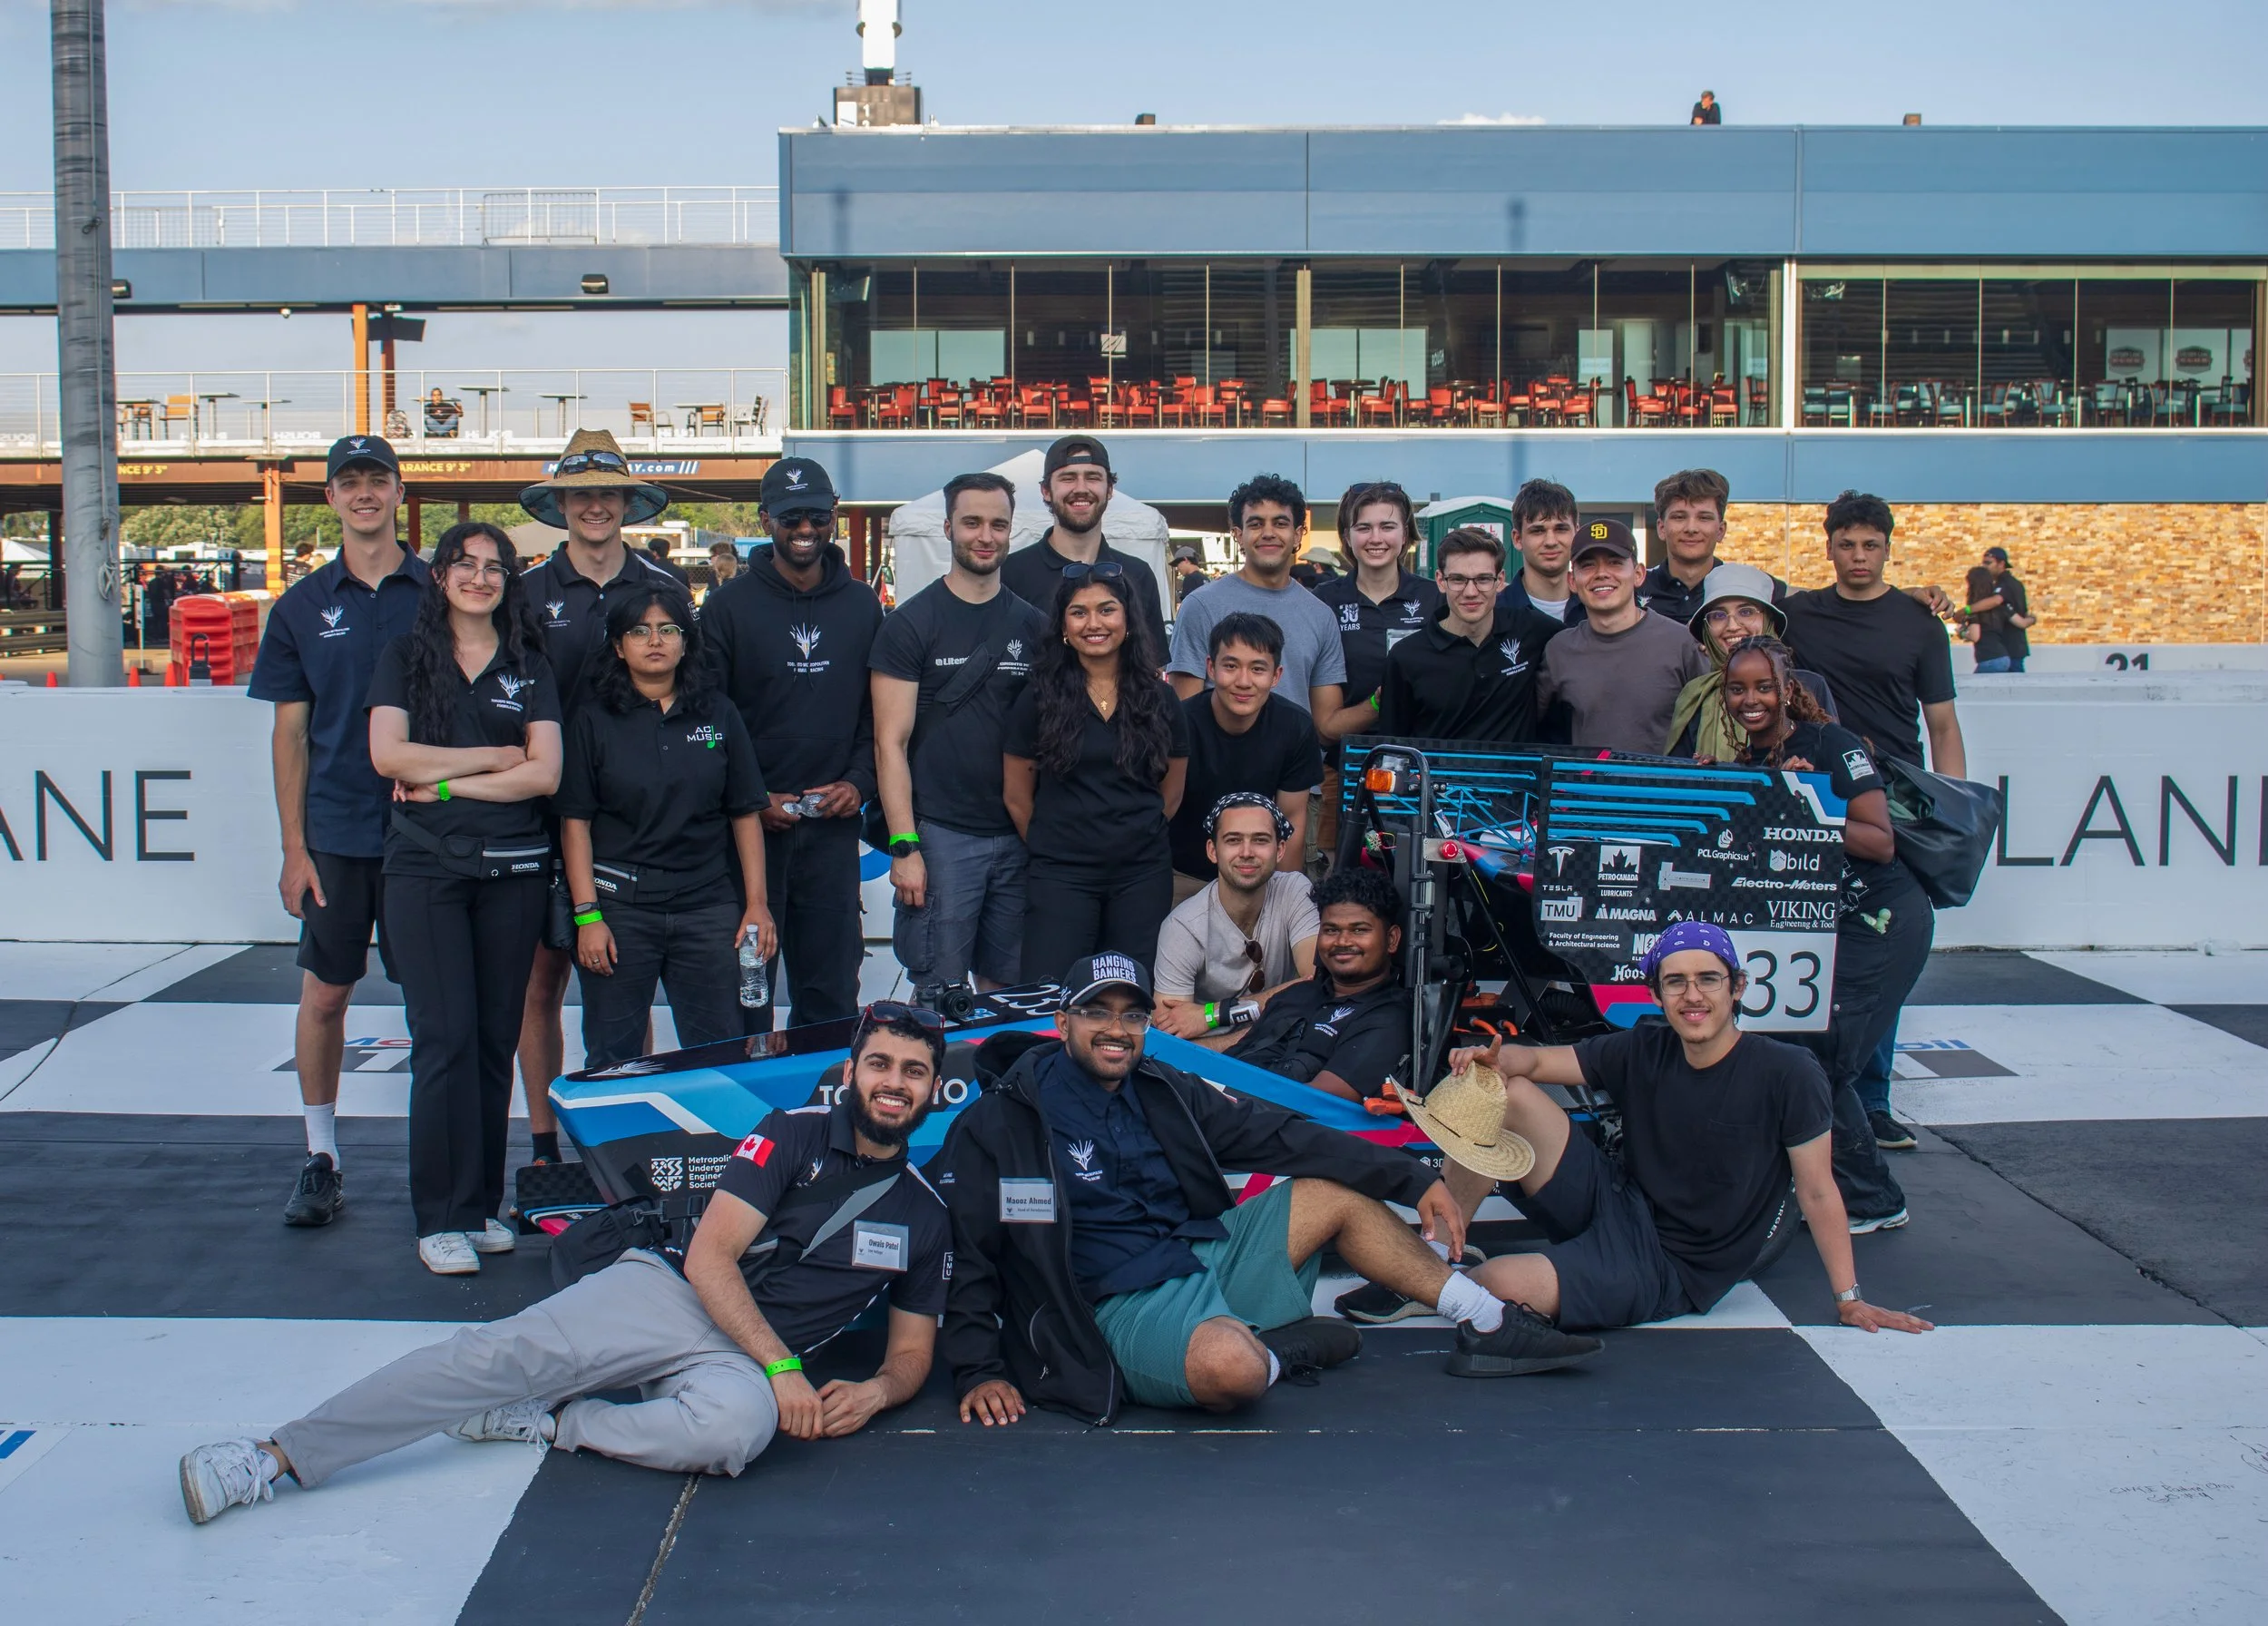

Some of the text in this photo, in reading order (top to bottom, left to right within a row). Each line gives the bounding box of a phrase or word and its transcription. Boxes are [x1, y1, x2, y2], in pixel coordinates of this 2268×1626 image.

[1591, 524, 1608, 539] SD
[0, 770, 195, 861] NE
[1997, 775, 2268, 867] LAN
[1764, 828, 1843, 843] HONDA
[1697, 849, 1712, 858] PCL
[1712, 850, 1741, 861] Graphics
[1786, 853, 1820, 871] bild
[594, 877, 618, 889] ONDA
[1731, 877, 1837, 891] Electro-Meters
[1545, 905, 1576, 917] TMU
[1609, 908, 1657, 921] MAGNA
[1766, 900, 1836, 920] VIKING
[1686, 911, 1754, 925] ALMAC
[1770, 919, 1811, 929] Engineering
[1821, 920, 1835, 928] Tool
[1092, 955, 1134, 971] HANGING
[1093, 968, 1136, 983] BANNERS
[1029, 1197, 1051, 1205] Ahmed
[868, 1239, 899, 1251] Owais Patel
